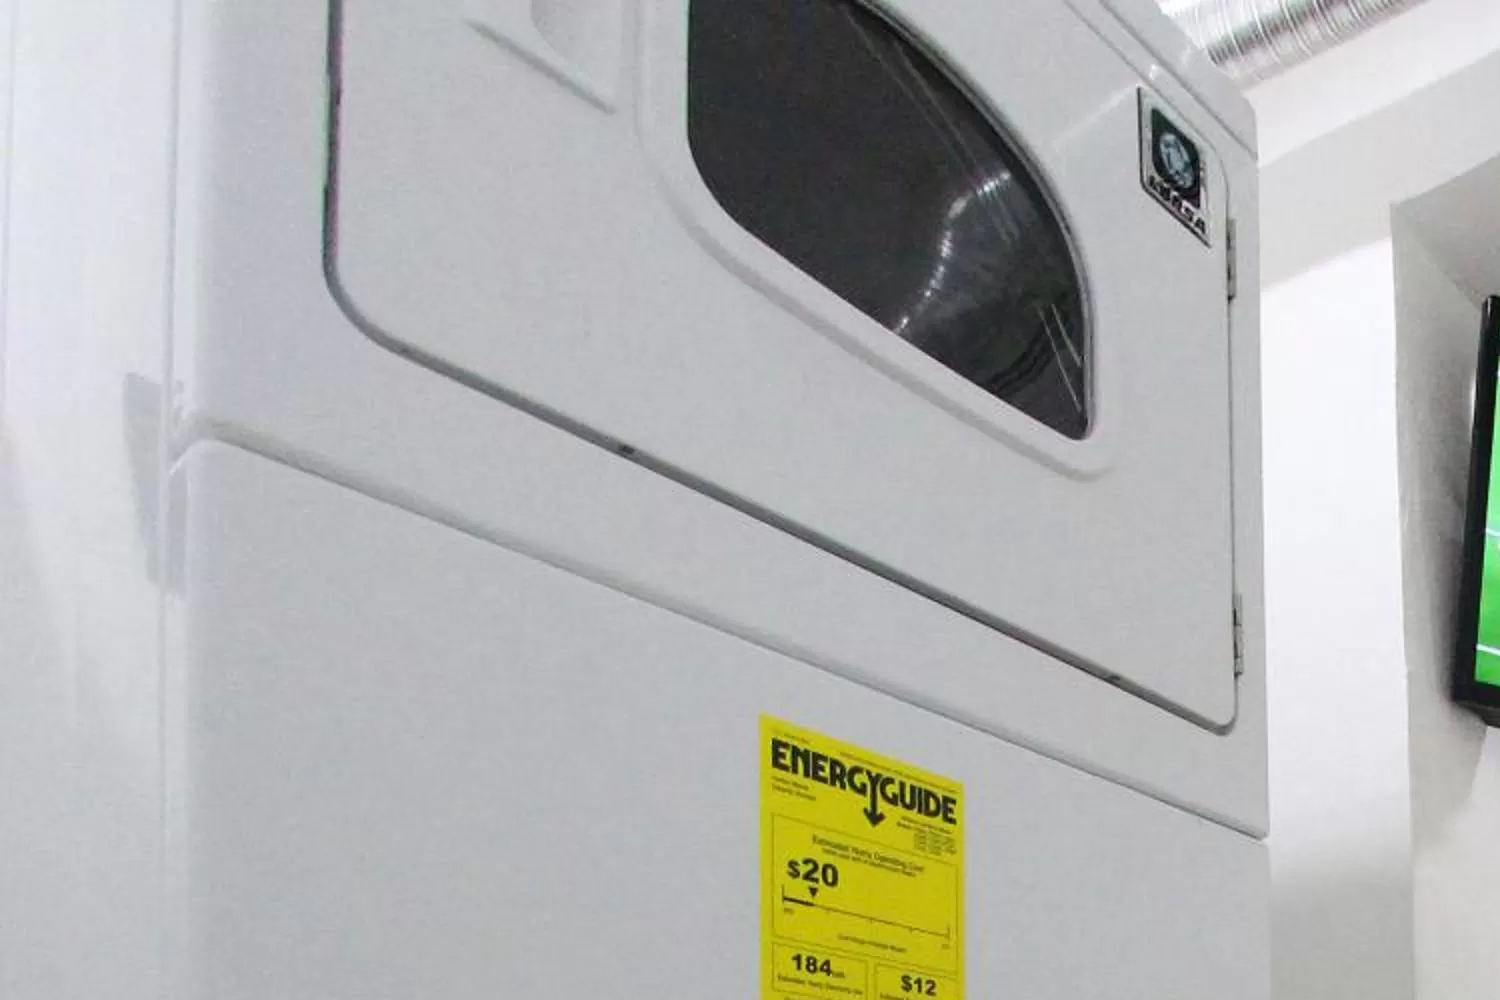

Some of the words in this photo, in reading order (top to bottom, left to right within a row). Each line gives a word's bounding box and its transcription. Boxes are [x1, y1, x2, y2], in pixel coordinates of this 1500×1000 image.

[771, 737, 957, 826] ENERGYGUIDE
[787, 857, 838, 887] $20
[792, 953, 831, 977] 184
[901, 975, 937, 997] $12
